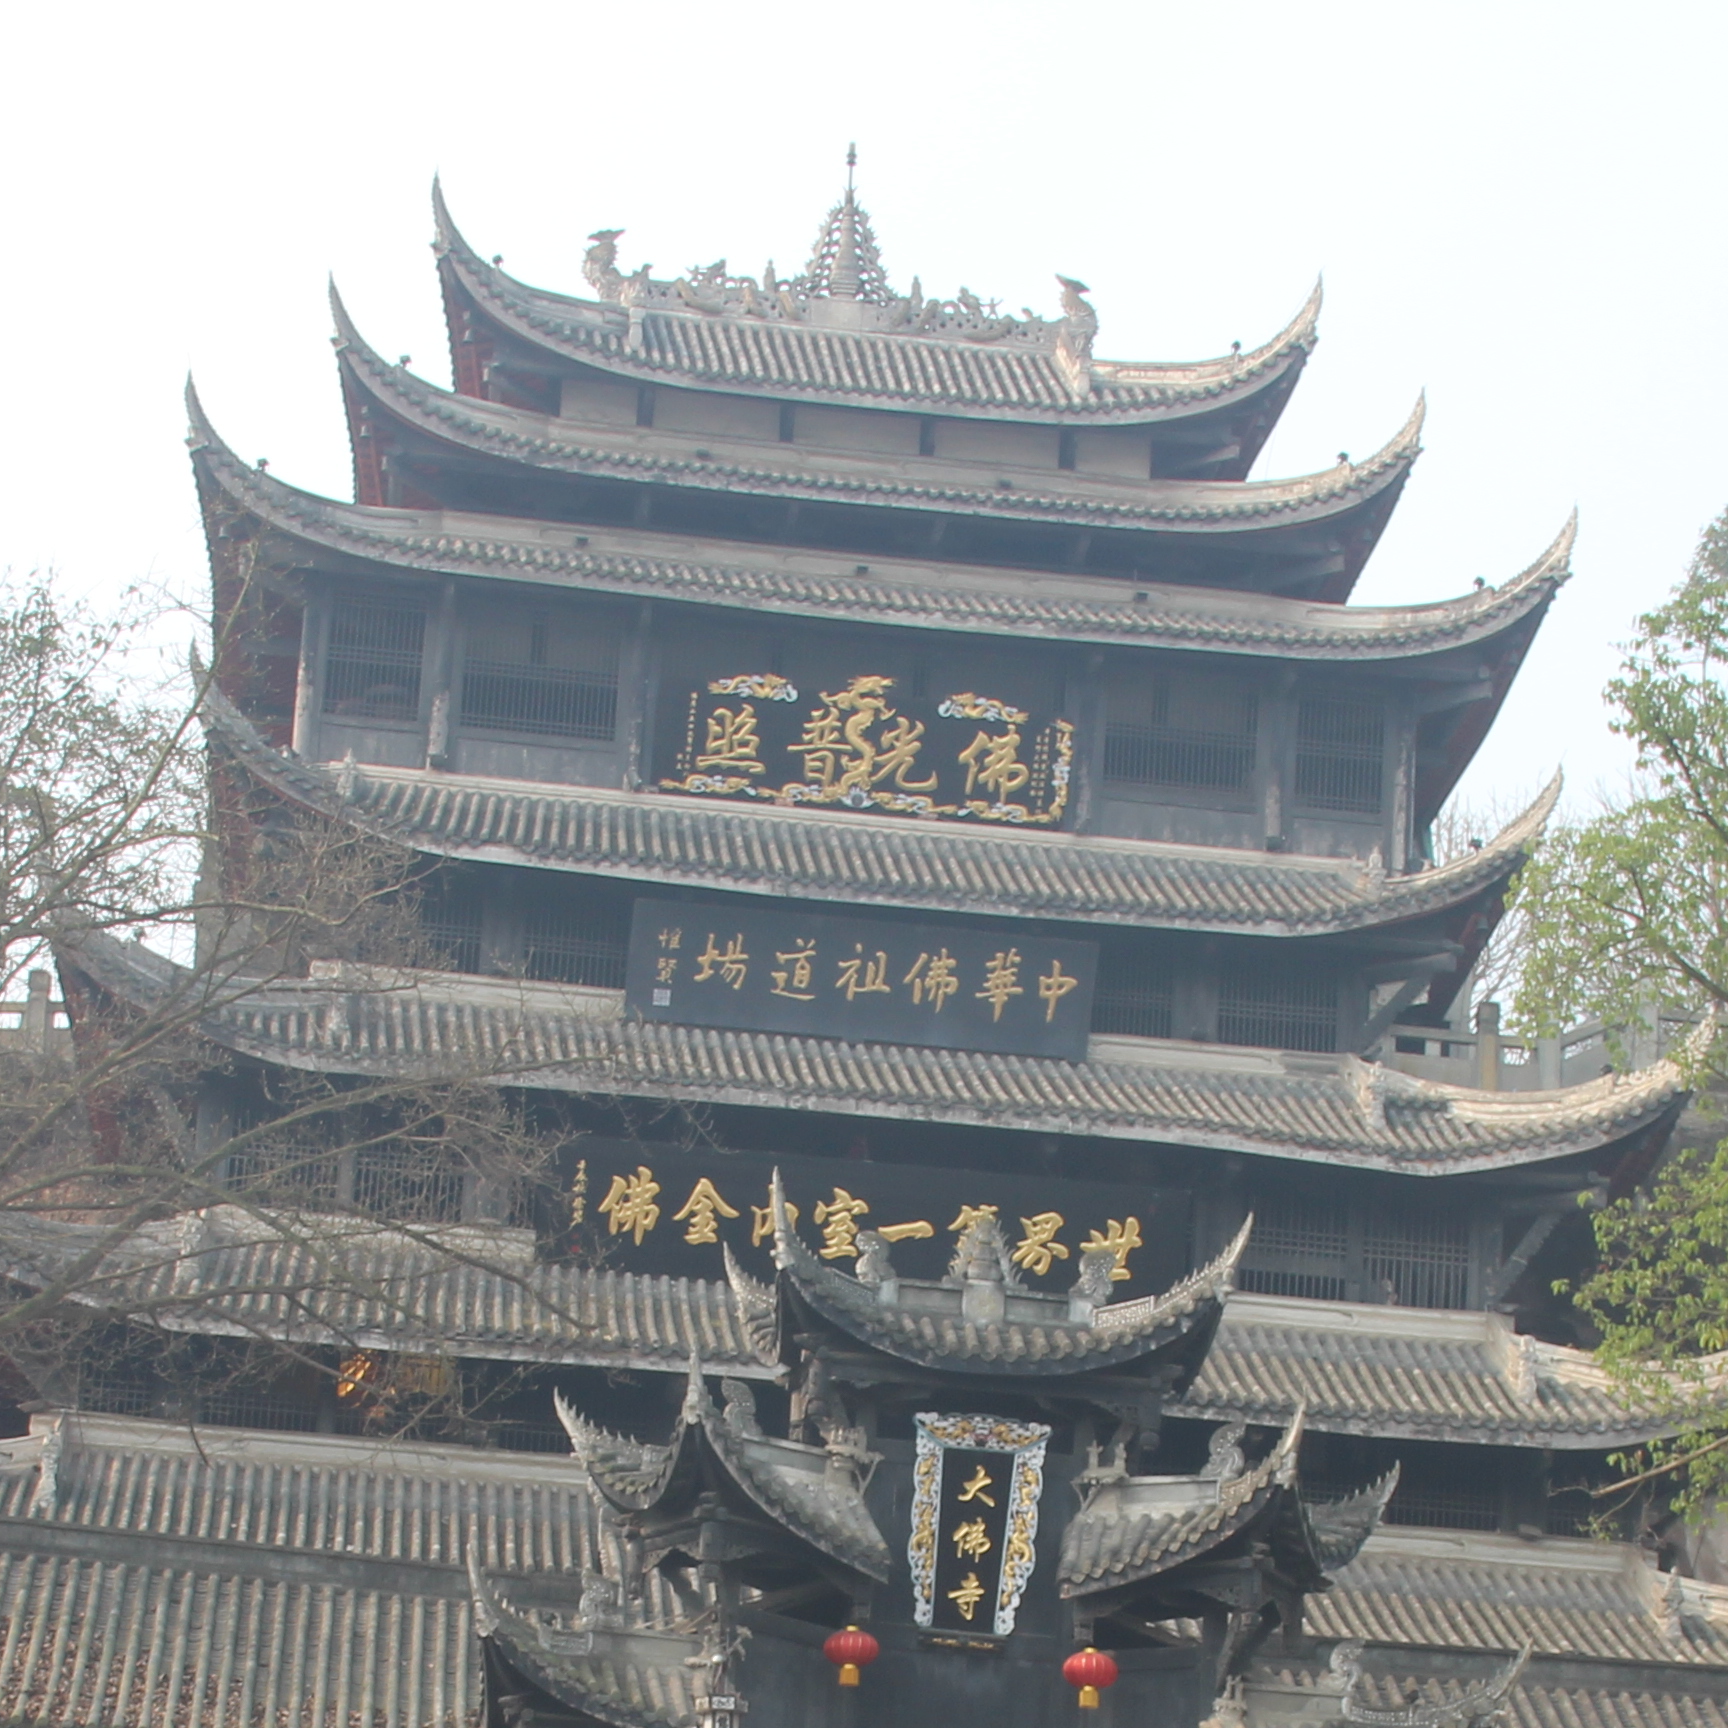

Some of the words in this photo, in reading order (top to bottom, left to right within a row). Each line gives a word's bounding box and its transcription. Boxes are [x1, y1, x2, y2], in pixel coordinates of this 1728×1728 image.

[695, 703, 1030, 804] 佛光普照
[947, 1465, 995, 1621] 大佛寺
